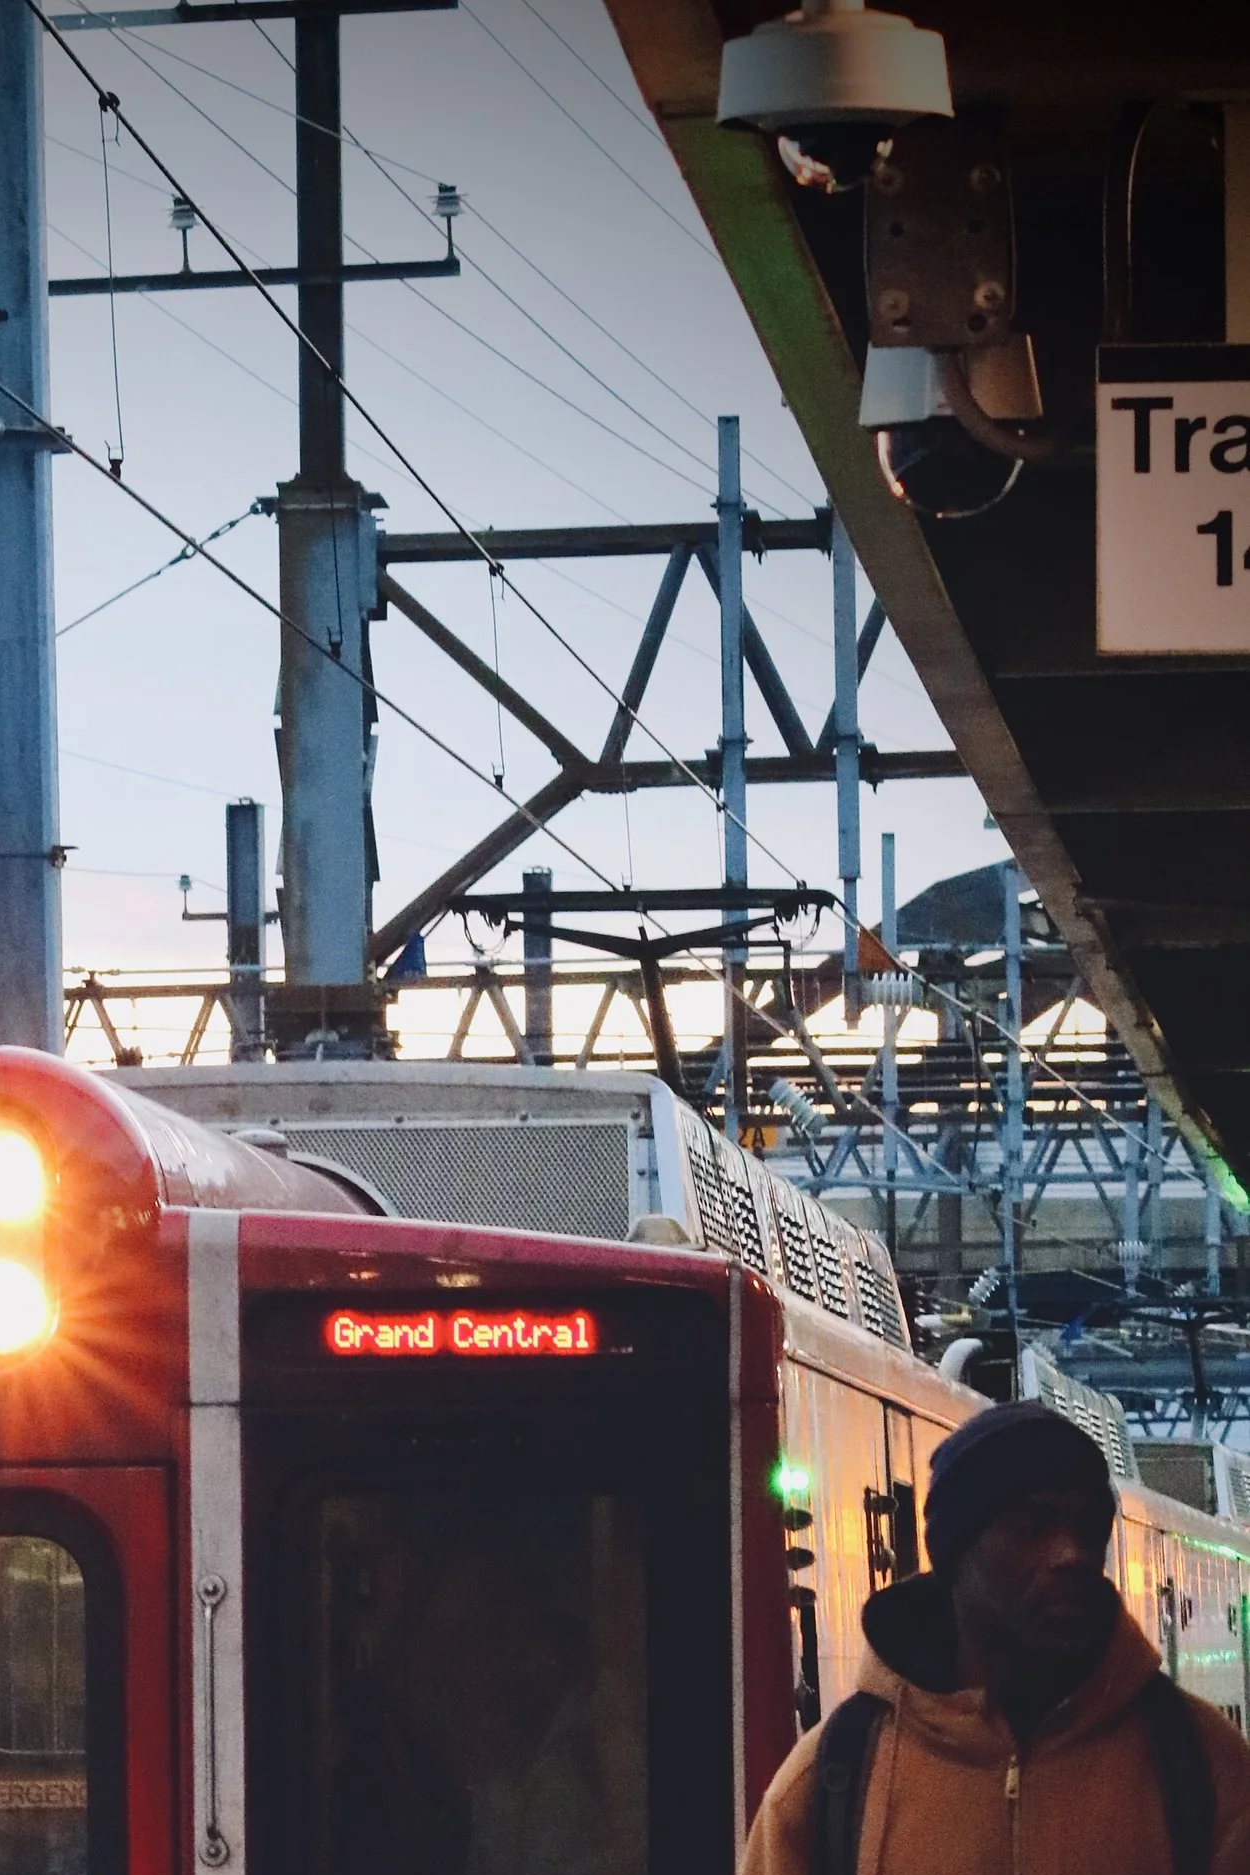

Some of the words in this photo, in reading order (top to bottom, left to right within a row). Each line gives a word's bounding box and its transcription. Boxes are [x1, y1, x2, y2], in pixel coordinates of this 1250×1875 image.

[1196, 509, 1250, 587] 1
[334, 1316, 435, 1349] Grand
[453, 1316, 589, 1349] Central
